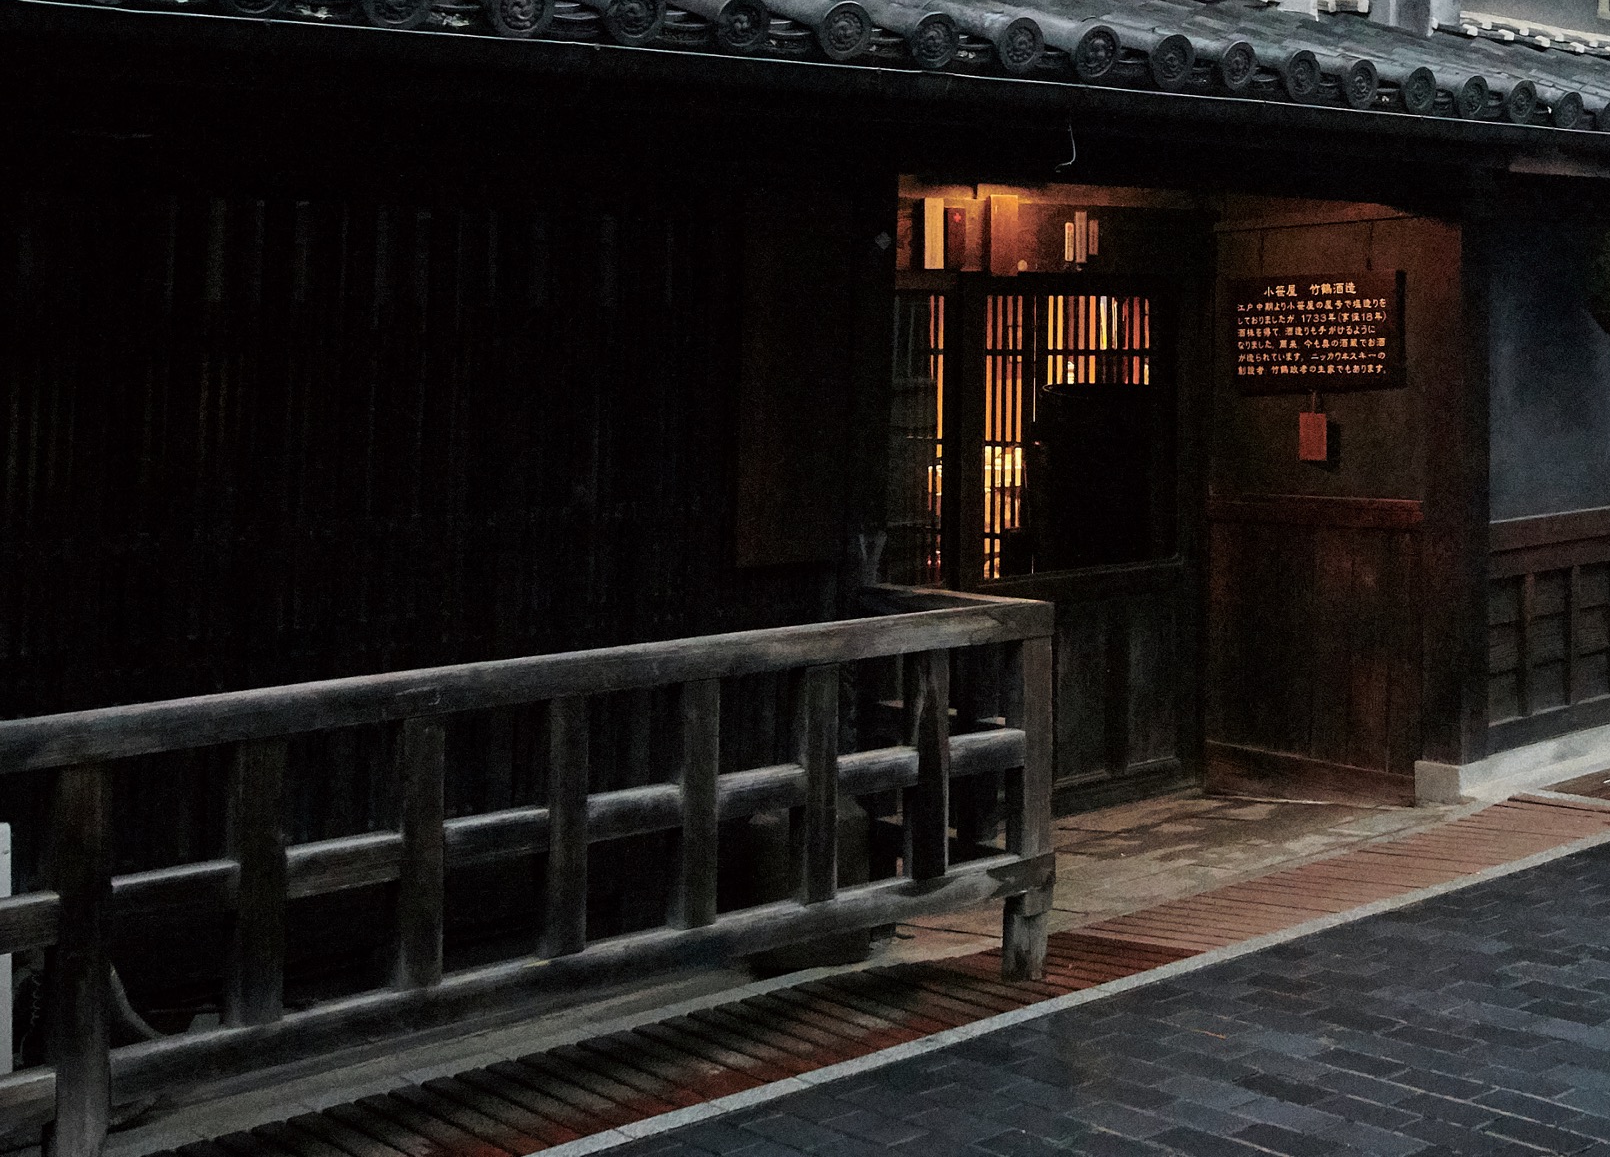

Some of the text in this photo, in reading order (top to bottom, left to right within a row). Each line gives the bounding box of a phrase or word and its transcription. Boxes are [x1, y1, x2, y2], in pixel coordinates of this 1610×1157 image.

[1264, 282, 1357, 297] 小笹屋 竹鶴酒造
